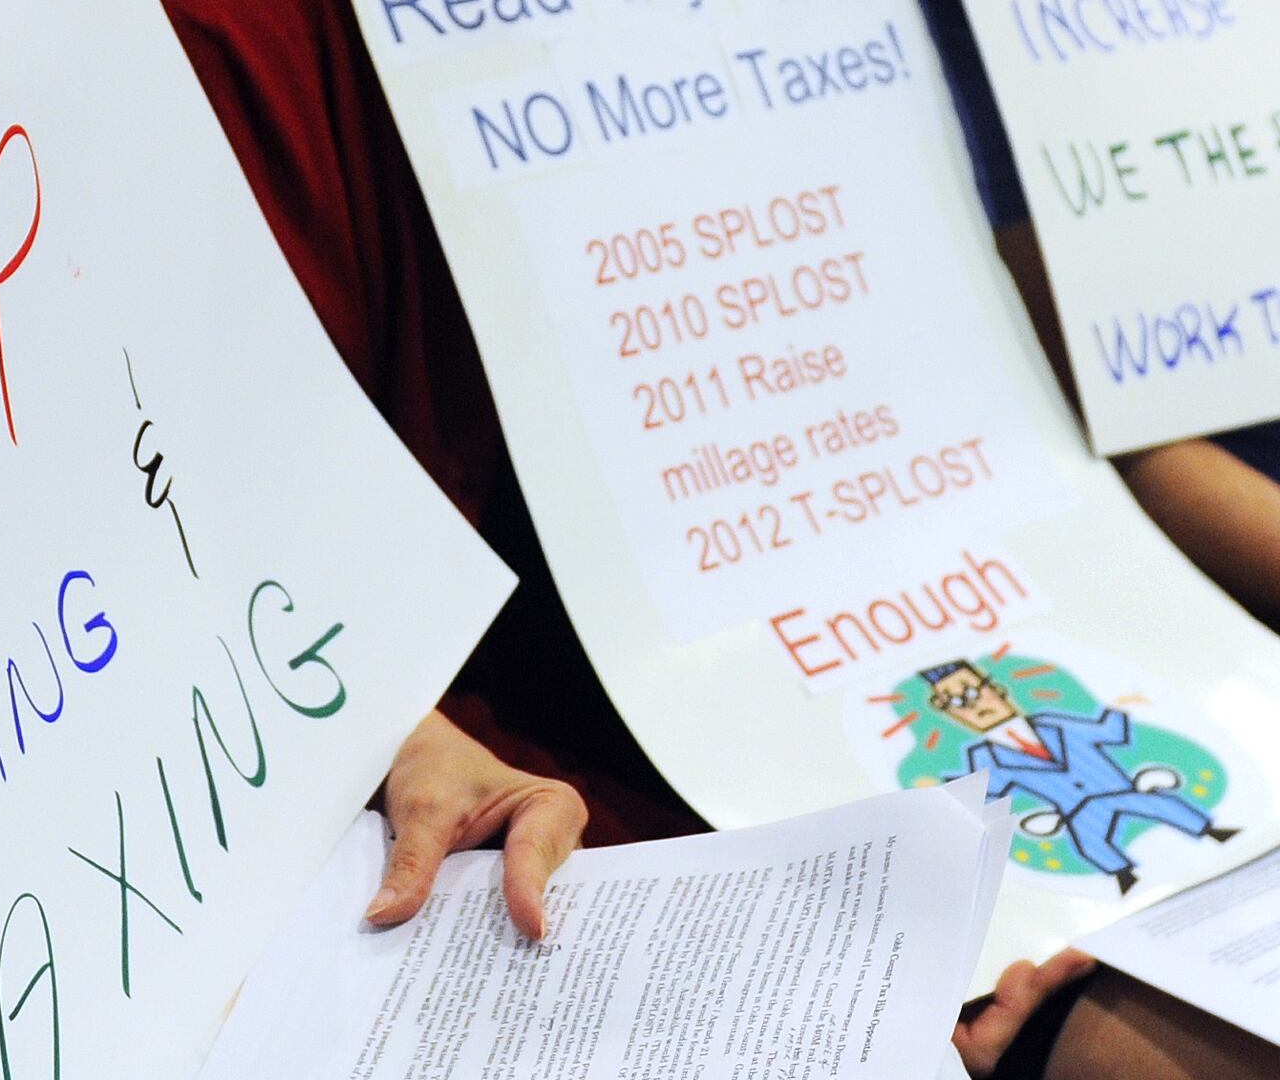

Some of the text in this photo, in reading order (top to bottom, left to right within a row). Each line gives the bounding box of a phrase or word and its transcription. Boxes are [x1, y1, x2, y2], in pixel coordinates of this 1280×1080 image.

[471, 22, 912, 170] NO More Taxes!
[1042, 140, 1149, 218] WE
[1154, 124, 1267, 178] THE
[587, 186, 846, 286] 2005 SPLOST
[610, 253, 870, 359] 2010 SPLOST
[1095, 303, 1246, 385] WORK
[634, 345, 847, 430] 2011 Raise
[662, 404, 900, 501] millage rates
[687, 436, 995, 572] 2012 T-SPLOST
[769, 550, 1028, 677] Enough
